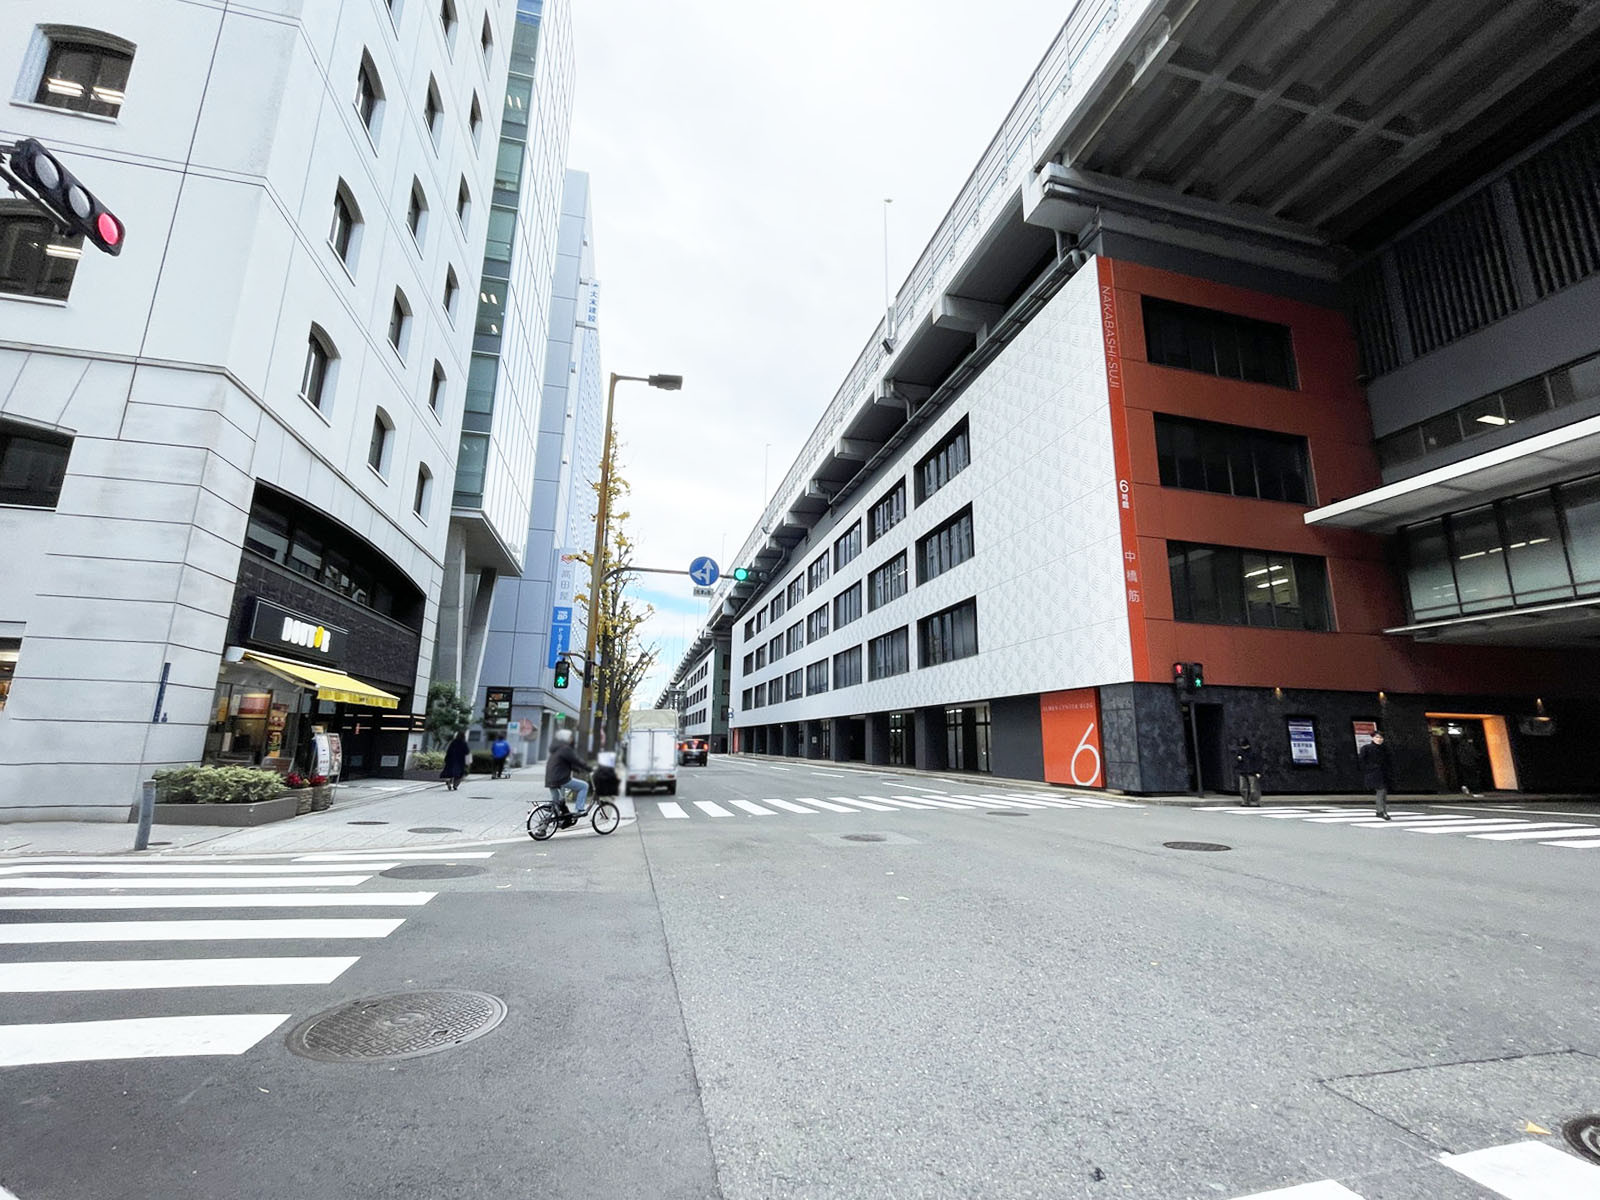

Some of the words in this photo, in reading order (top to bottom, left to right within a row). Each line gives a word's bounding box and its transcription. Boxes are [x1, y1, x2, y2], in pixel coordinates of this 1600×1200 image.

[1101, 285, 1120, 389] NAKABASHI-SUJI
[1124, 550, 1140, 603] 中橋筋
[281, 616, 331, 653] DOUTOR
[1070, 721, 1101, 787] 6
